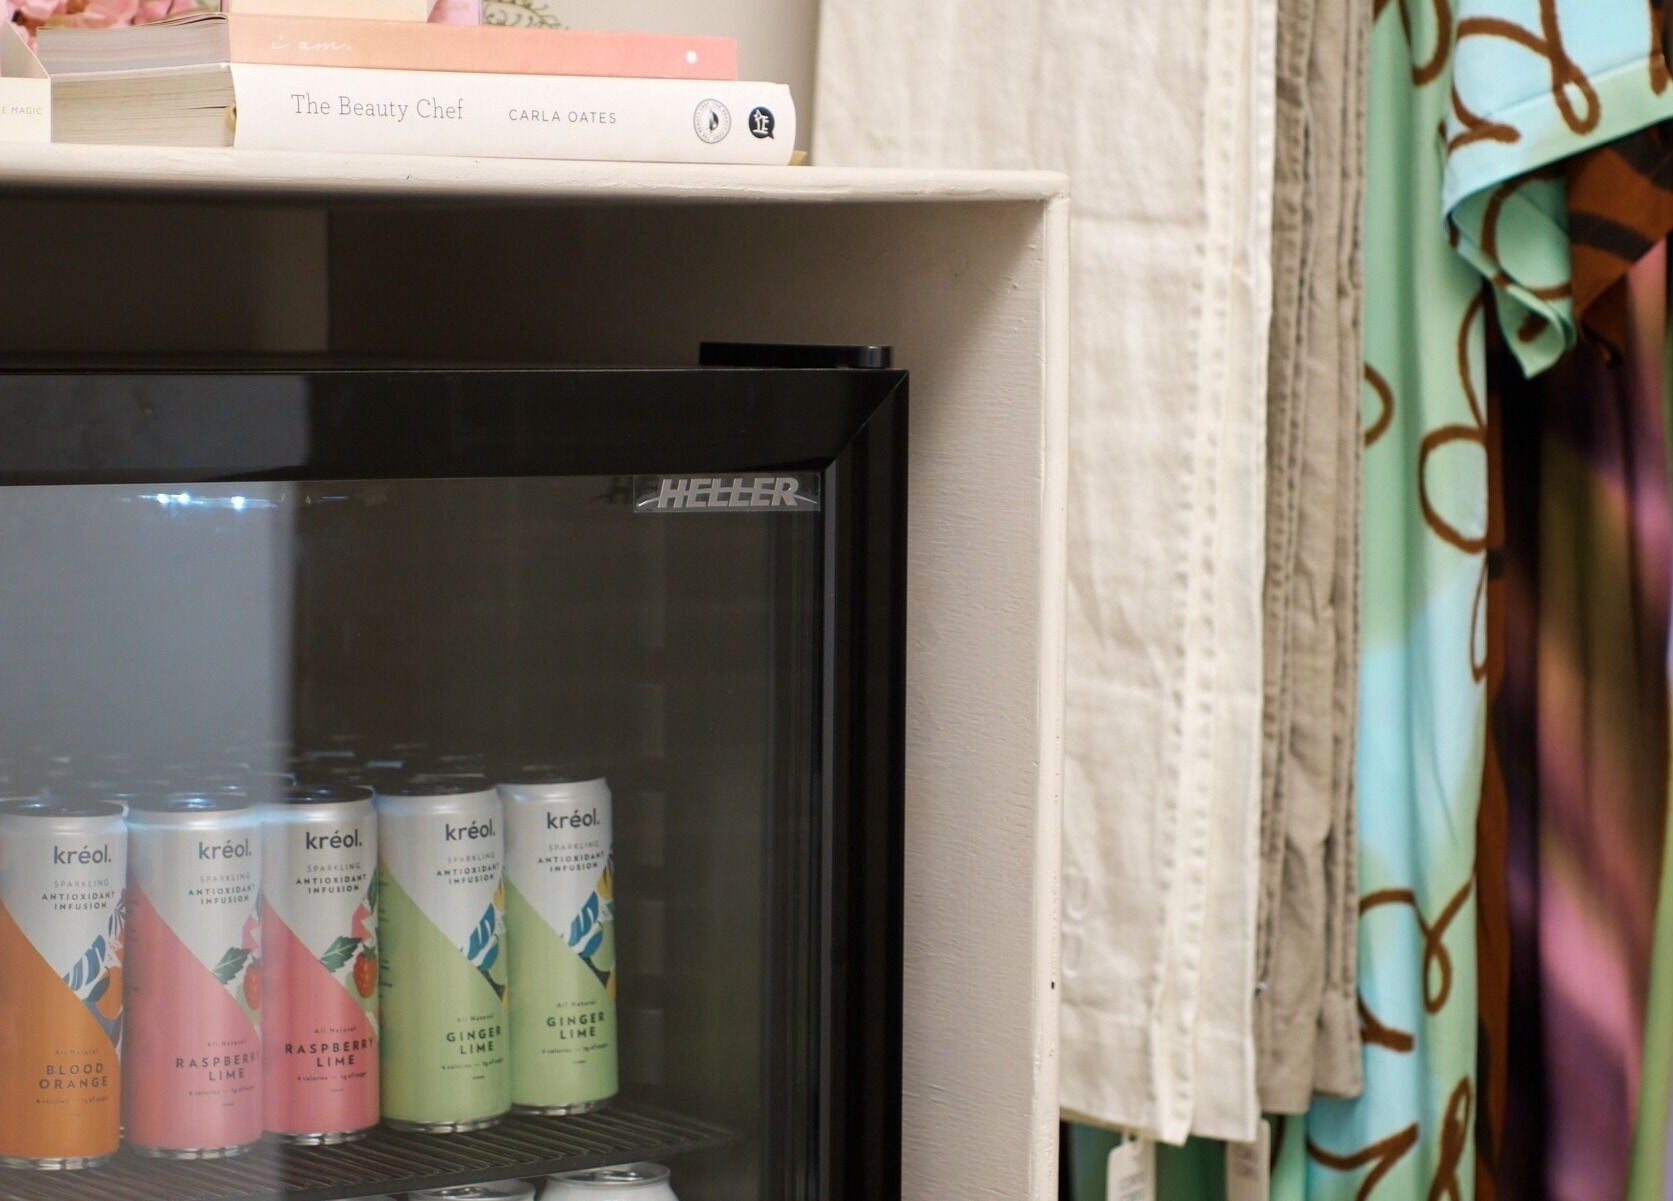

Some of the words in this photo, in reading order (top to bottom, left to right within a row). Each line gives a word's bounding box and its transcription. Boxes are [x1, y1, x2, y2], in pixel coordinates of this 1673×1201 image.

[10, 105, 44, 116] MAGIC
[291, 92, 331, 115] The
[338, 96, 409, 123] Beauty
[416, 97, 464, 120] Chef
[508, 109, 562, 123] CARLA
[567, 111, 618, 125] OATES
[657, 476, 800, 509] HELLER
[546, 808, 600, 829] kréol.
[445, 818, 496, 841] kréol.
[306, 829, 362, 850] kréol.
[548, 840, 600, 852] SPARKLING
[53, 844, 112, 865] kréol.
[198, 838, 252, 860] kréol.
[537, 850, 605, 863] ANTIOXIDANT
[306, 861, 361, 873] SPARKLING
[436, 862, 500, 876] ANTIOXIDANT
[549, 862, 598, 872] INFUSION
[54, 878, 110, 888] SPARKLING
[200, 872, 251, 883] SPARKLING
[296, 873, 367, 885] ANTIOXIDANT
[448, 874, 494, 885] INFUSION
[42, 891, 115, 901] ANTIOXIDANT
[188, 883, 255, 896] ANTIOXIDANT
[308, 885, 359, 894] INFUSION
[200, 895, 249, 904] INFUSION
[54, 902, 107, 911] INFUSION
[546, 1011, 604, 1027] GINGER
[446, 1025, 501, 1042] GINGER
[560, 1026, 596, 1040] LIME
[285, 1037, 373, 1054] RASPBERRY
[460, 1041, 494, 1055] LIME
[316, 1055, 355, 1068] LIME
[46, 1063, 103, 1075] BLOOD
[208, 1067, 245, 1081] LIME
[39, 1075, 108, 1089] ORANGE
